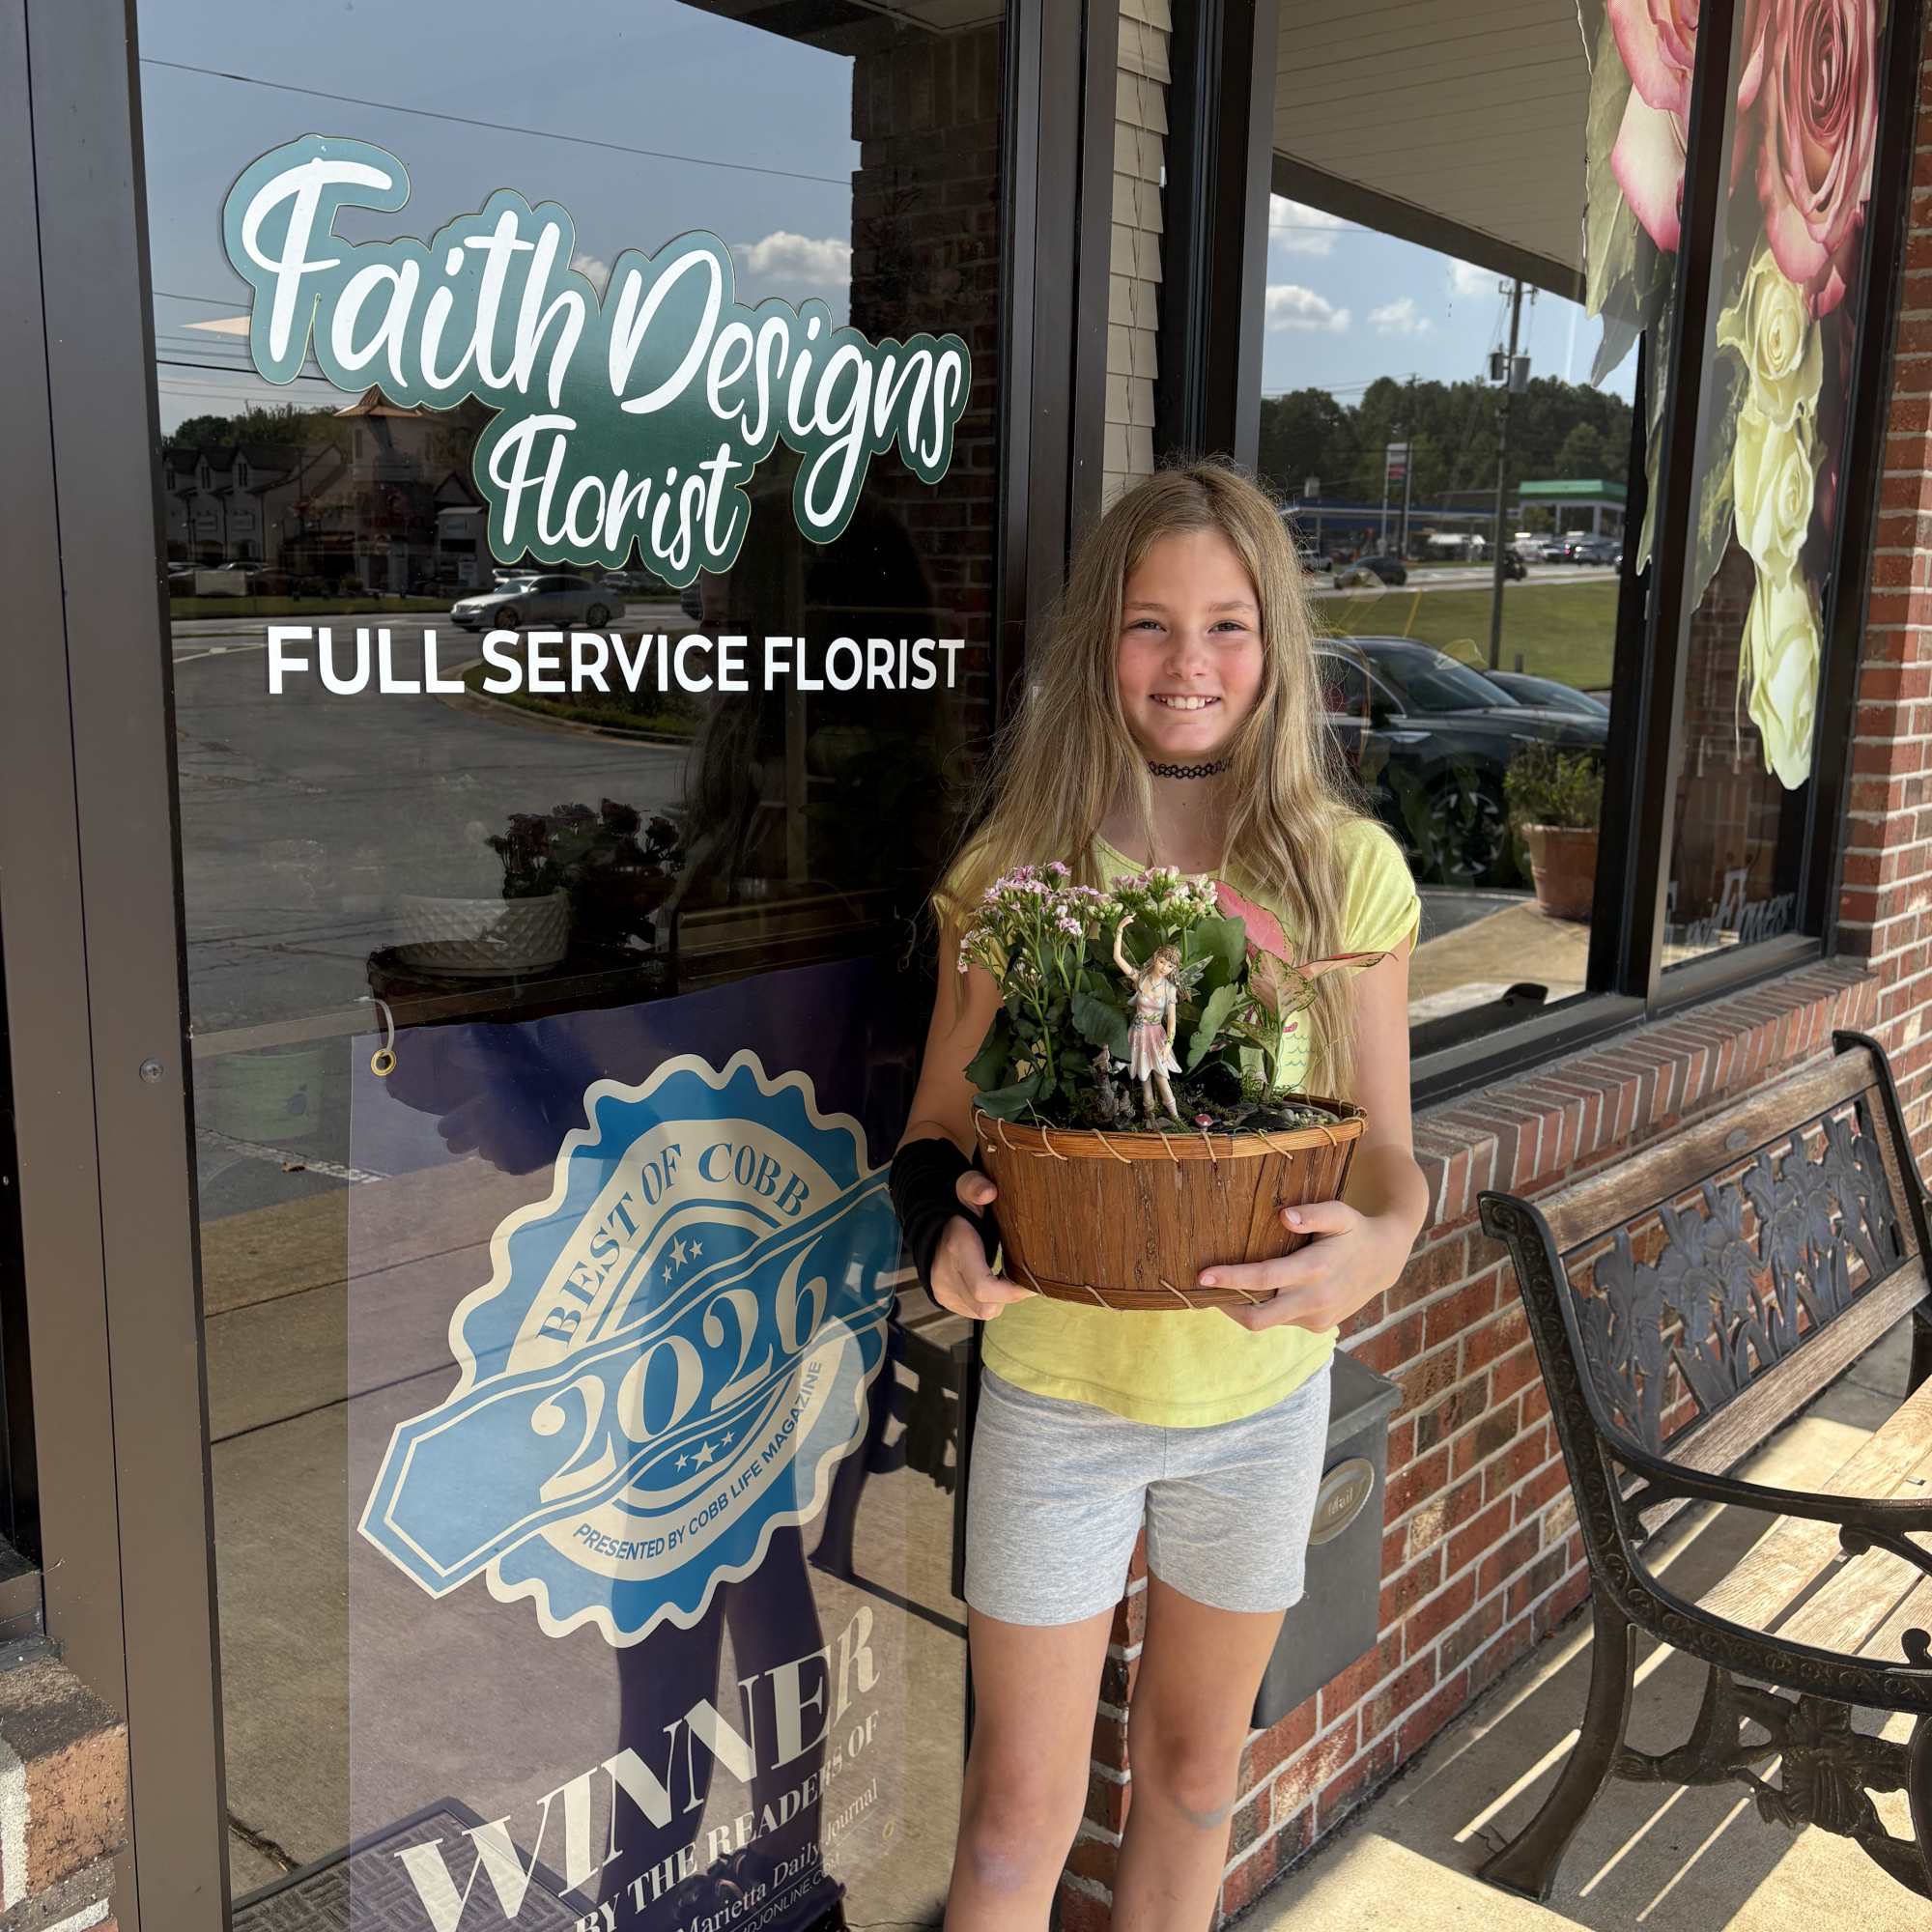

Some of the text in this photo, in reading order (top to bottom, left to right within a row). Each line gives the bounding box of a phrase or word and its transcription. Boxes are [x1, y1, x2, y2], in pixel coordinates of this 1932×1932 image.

[242, 156, 964, 528] Faith Designs
[487, 412, 744, 572] Florist
[268, 625, 966, 696] FULL SERVICE FLORIST
[534, 1143, 810, 1350] BEST OF COBB
[531, 1236, 828, 1503] 2026
[572, 1361, 822, 1560] PRESENTED BY COBB LIFE MAGAZINE
[394, 1605, 880, 1932] WINNER
[574, 1710, 880, 1932] BY THE READERS OF
[671, 1778, 879, 1932] Marietta Daily Journal
